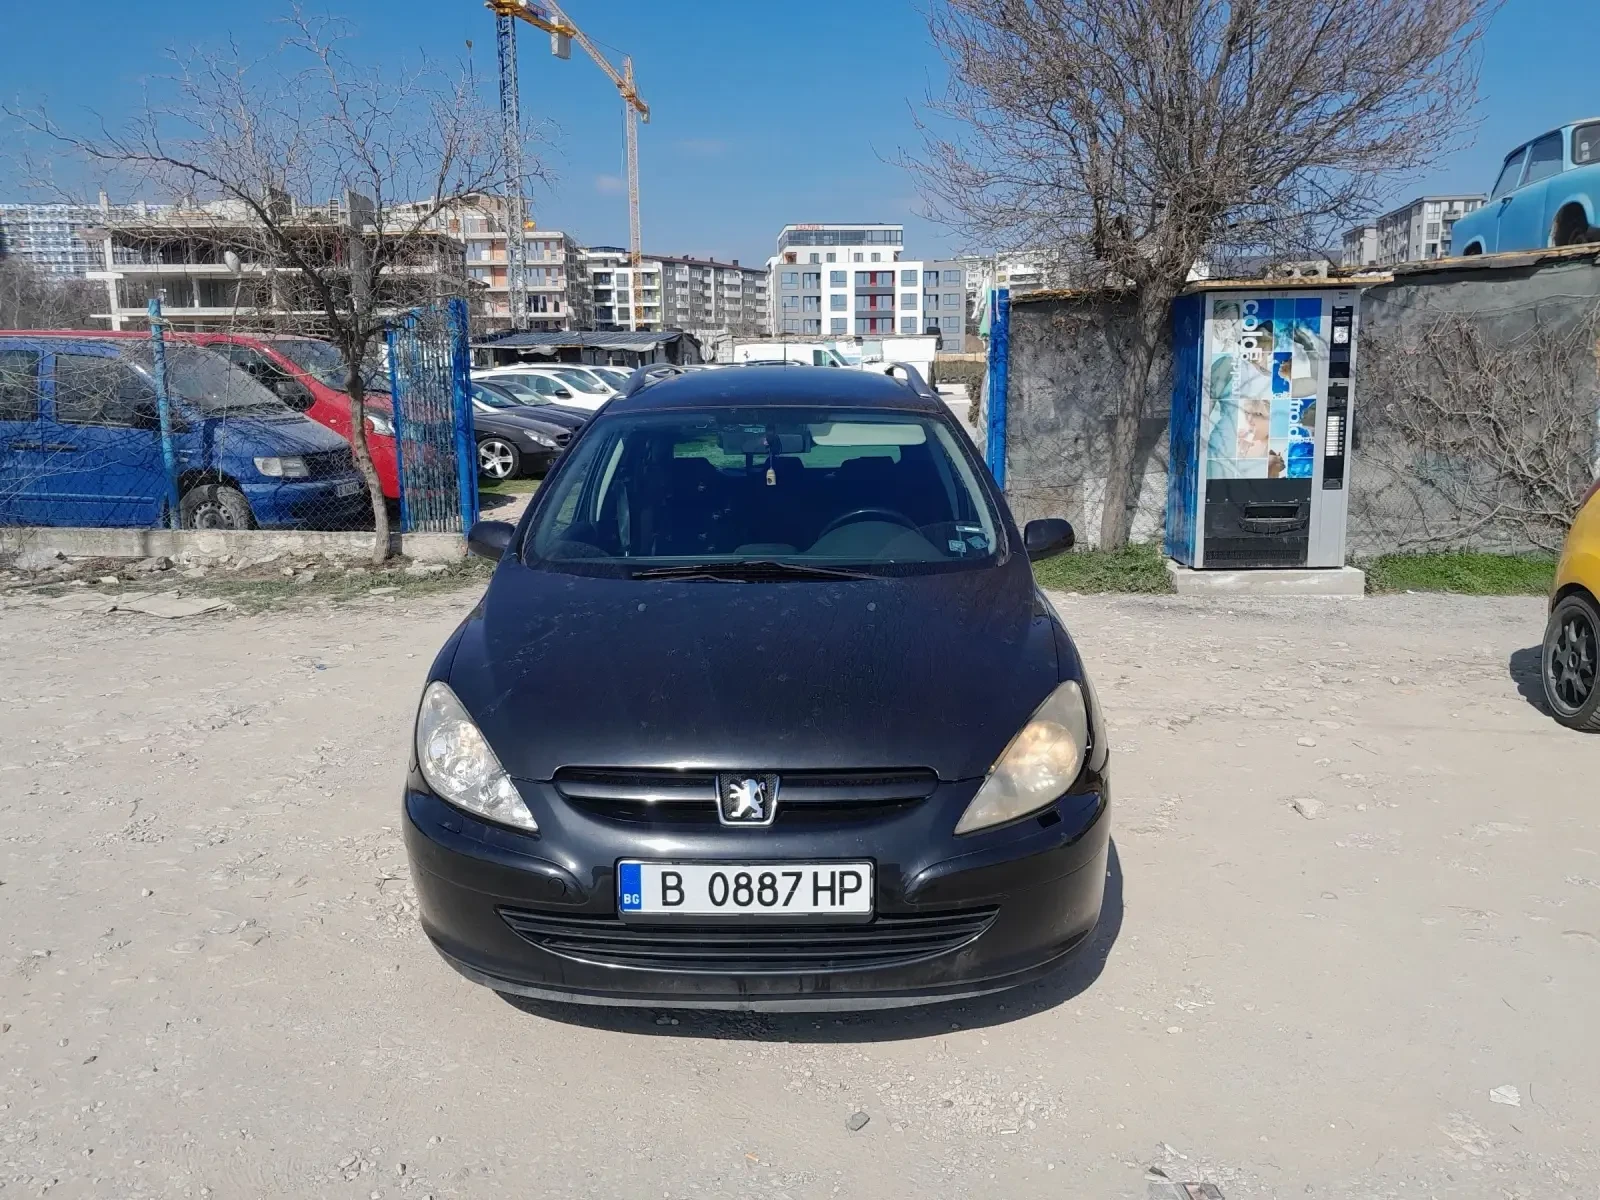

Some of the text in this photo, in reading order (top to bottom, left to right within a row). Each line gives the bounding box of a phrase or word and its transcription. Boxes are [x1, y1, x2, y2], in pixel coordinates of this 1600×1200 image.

[1288, 399, 1304, 439] froid
[623, 894, 640, 905] BG
[661, 870, 685, 907] B
